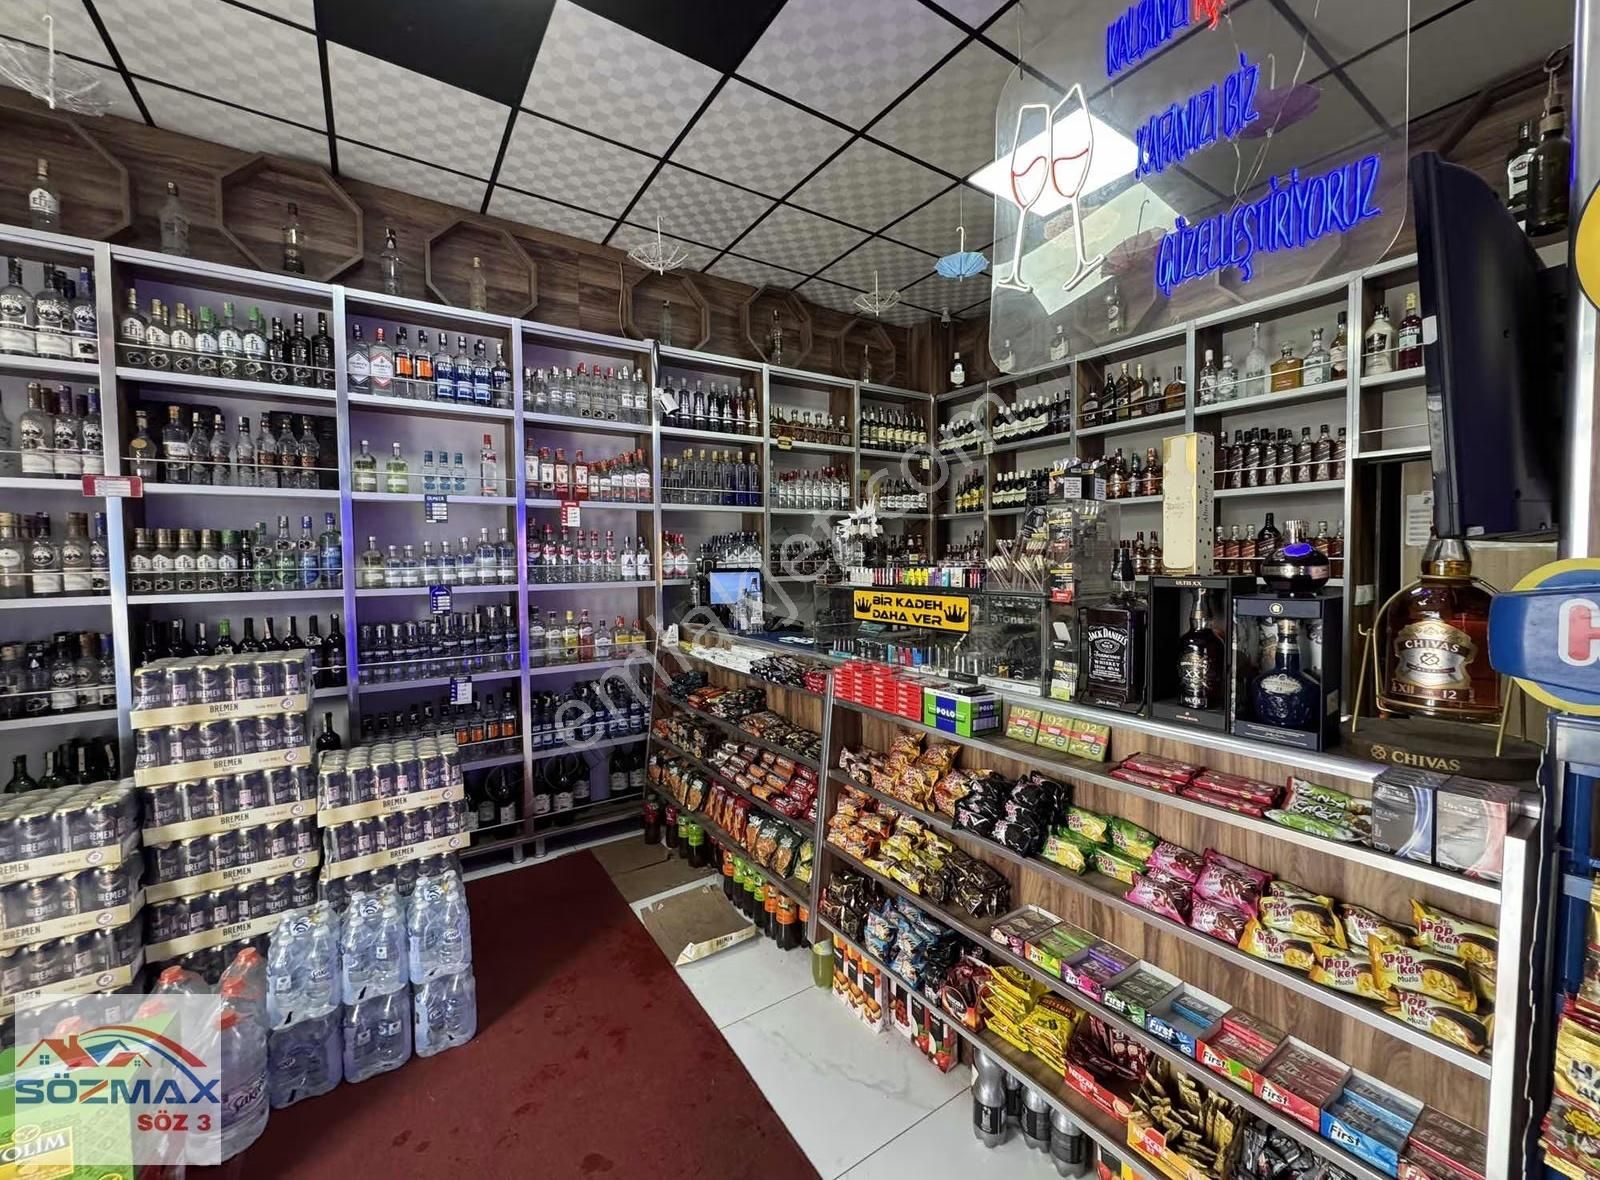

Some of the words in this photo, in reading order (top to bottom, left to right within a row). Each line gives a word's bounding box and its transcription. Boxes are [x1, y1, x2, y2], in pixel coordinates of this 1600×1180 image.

[1135, 84, 1218, 180] KAFANIZI
[1224, 53, 1259, 138] BİZ
[1157, 154, 1381, 296] GÜZELLEŞTİRİYORUZ
[872, 594, 892, 606] BİR
[896, 597, 942, 611] KADEH
[872, 609, 908, 622] DAHA
[912, 613, 942, 626] VER
[1088, 630, 1102, 641] JACK
[1404, 639, 1460, 653] CHIVAS
[1442, 689, 1457, 700] 12
[209, 702, 239, 713] BREMEN
[936, 708, 956, 718] POLO
[979, 704, 994, 712] POLO
[213, 758, 243, 769] BREMEN
[1391, 751, 1461, 771] CHIVAS
[382, 797, 407, 808] BREMEN
[220, 812, 249, 825] BREMEN
[390, 846, 415, 857] BREMEN
[0, 863, 30, 875] REMEN
[223, 867, 252, 880] BREMEN
[3, 925, 41, 940] BREMEN
[222, 922, 252, 936] BREMEN
[1397, 975, 1419, 983] Muzlu
[1104, 991, 1126, 1011] First
[1149, 1018, 1175, 1038] First
[1203, 1051, 1226, 1068] First
[1262, 1085, 1288, 1105] First
[1330, 1124, 1361, 1146] First
